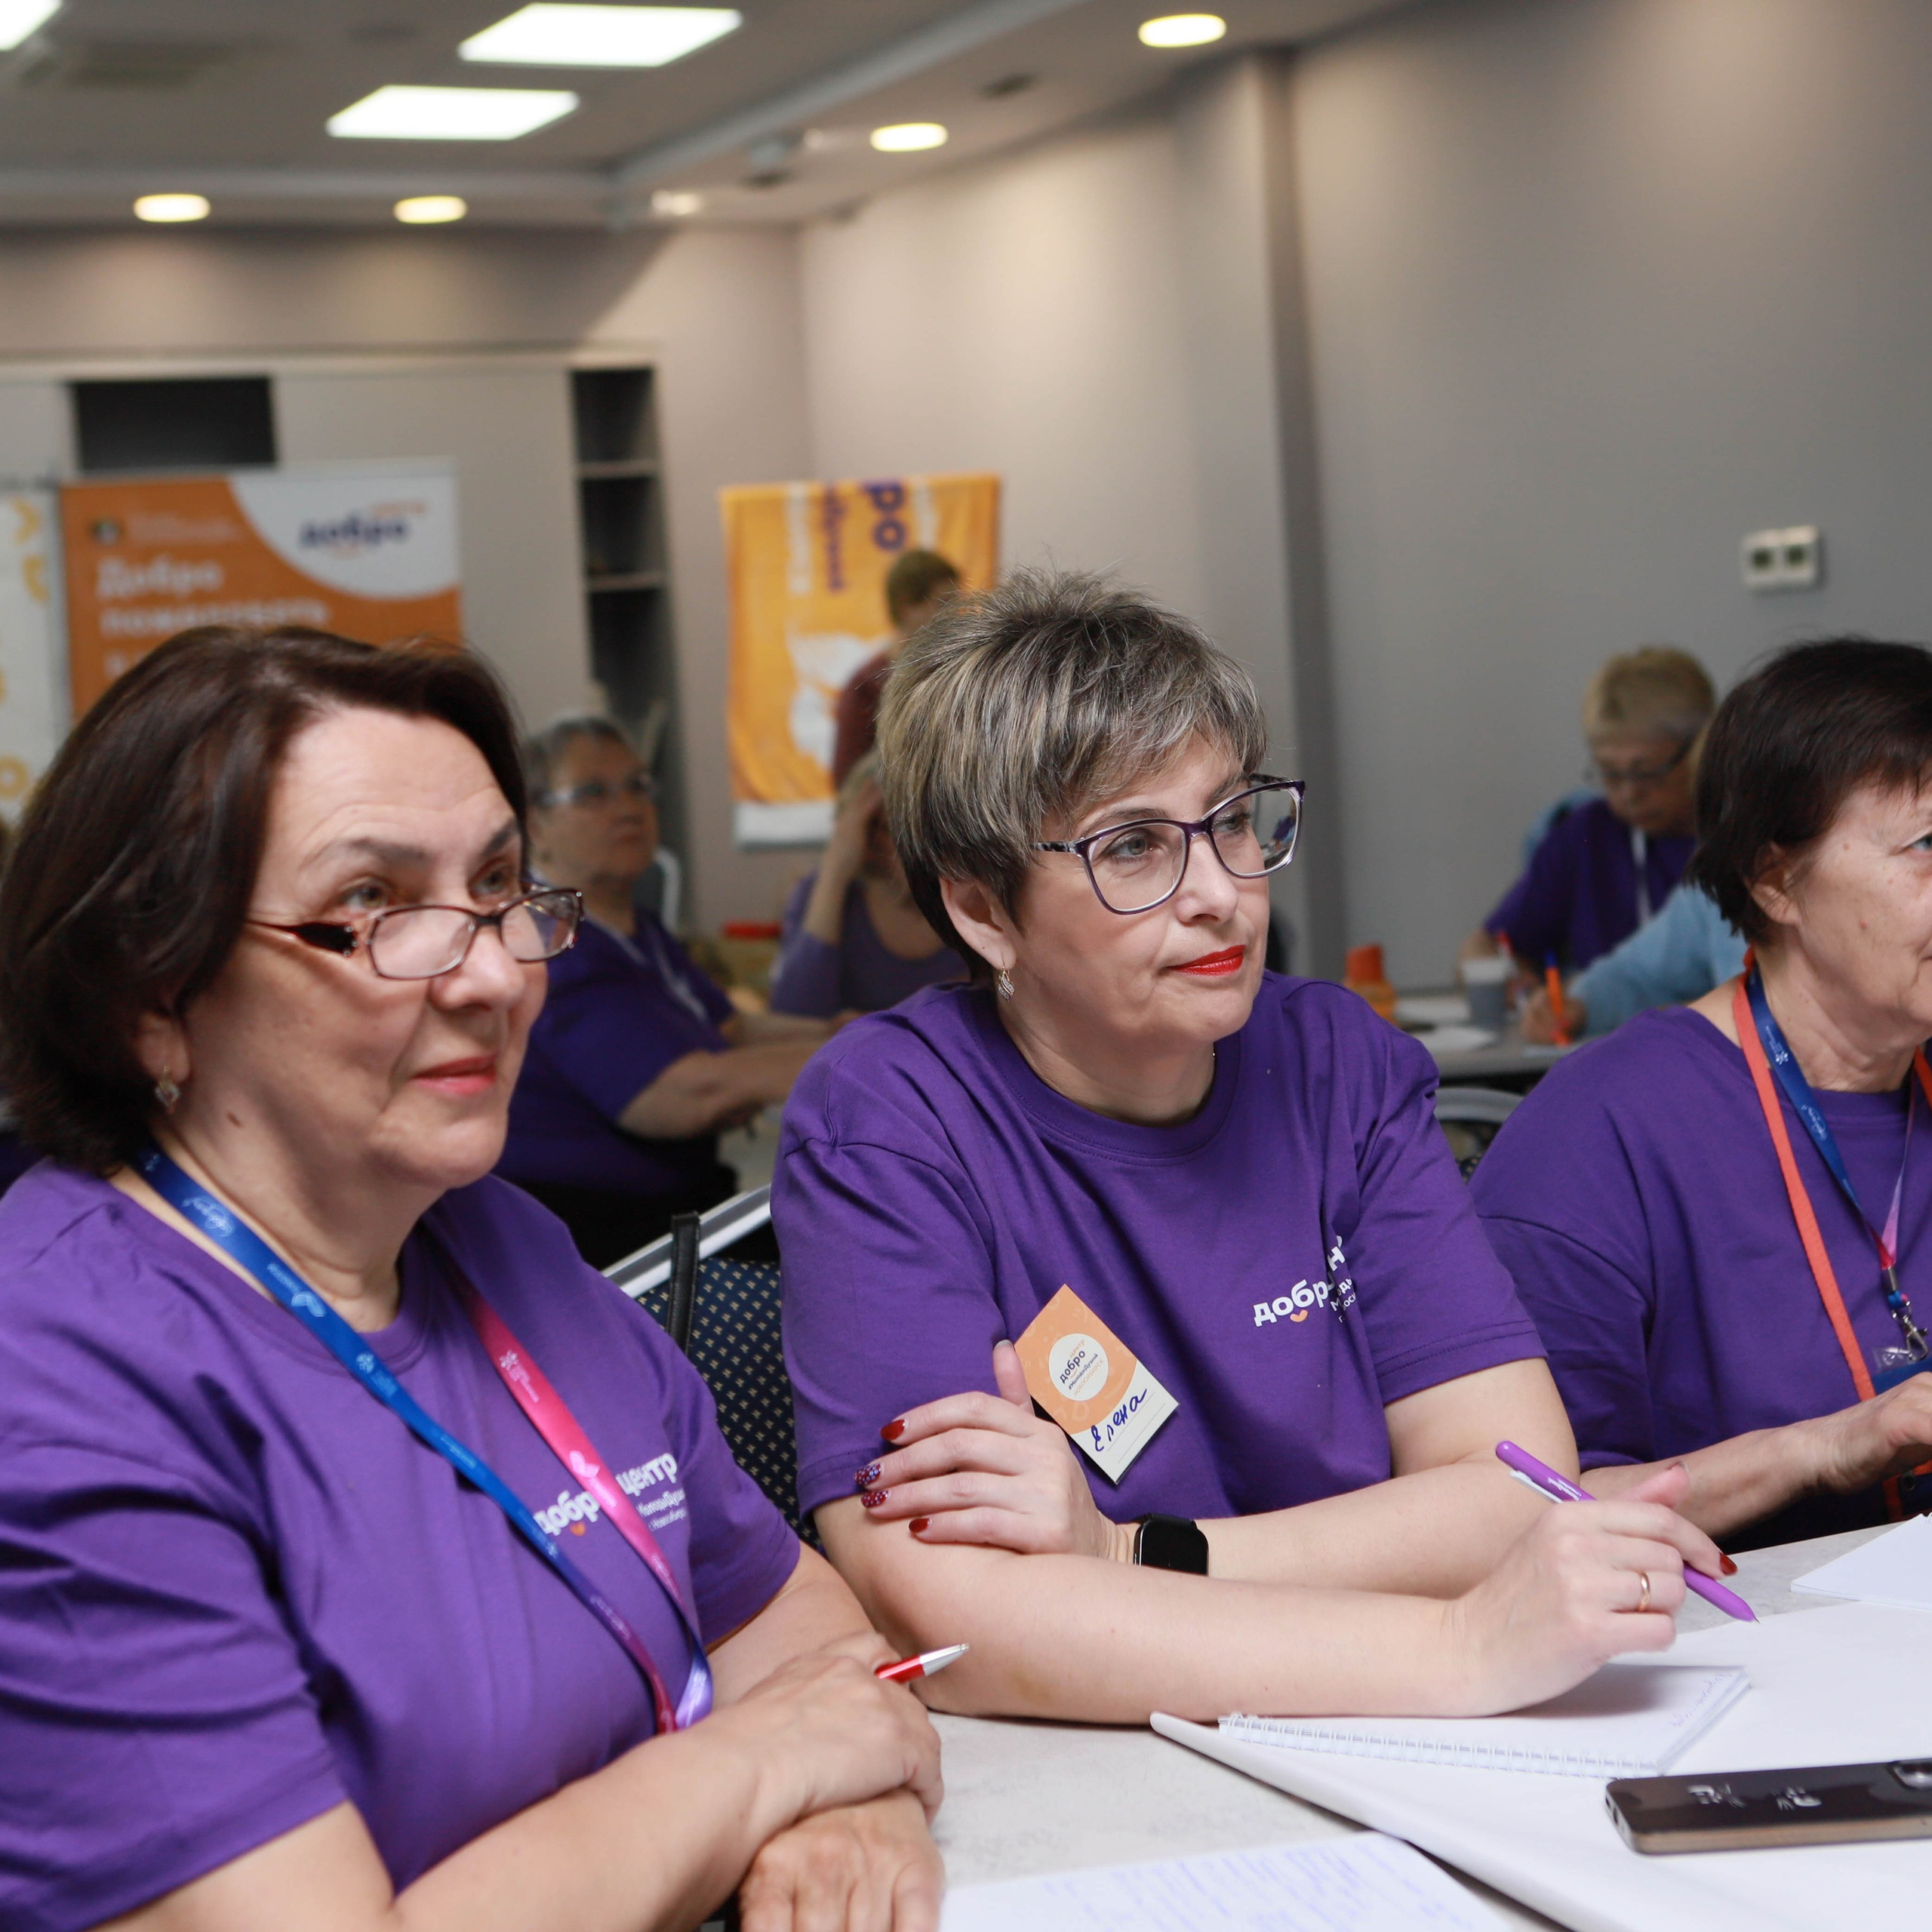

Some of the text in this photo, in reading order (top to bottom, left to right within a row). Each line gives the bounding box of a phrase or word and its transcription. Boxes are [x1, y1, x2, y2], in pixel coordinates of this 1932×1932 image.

[1060, 1350, 1085, 1384] добро
[1091, 1388, 1148, 1452] Елена
[533, 1490, 601, 1536] добр
[615, 1453, 678, 1497] центр
